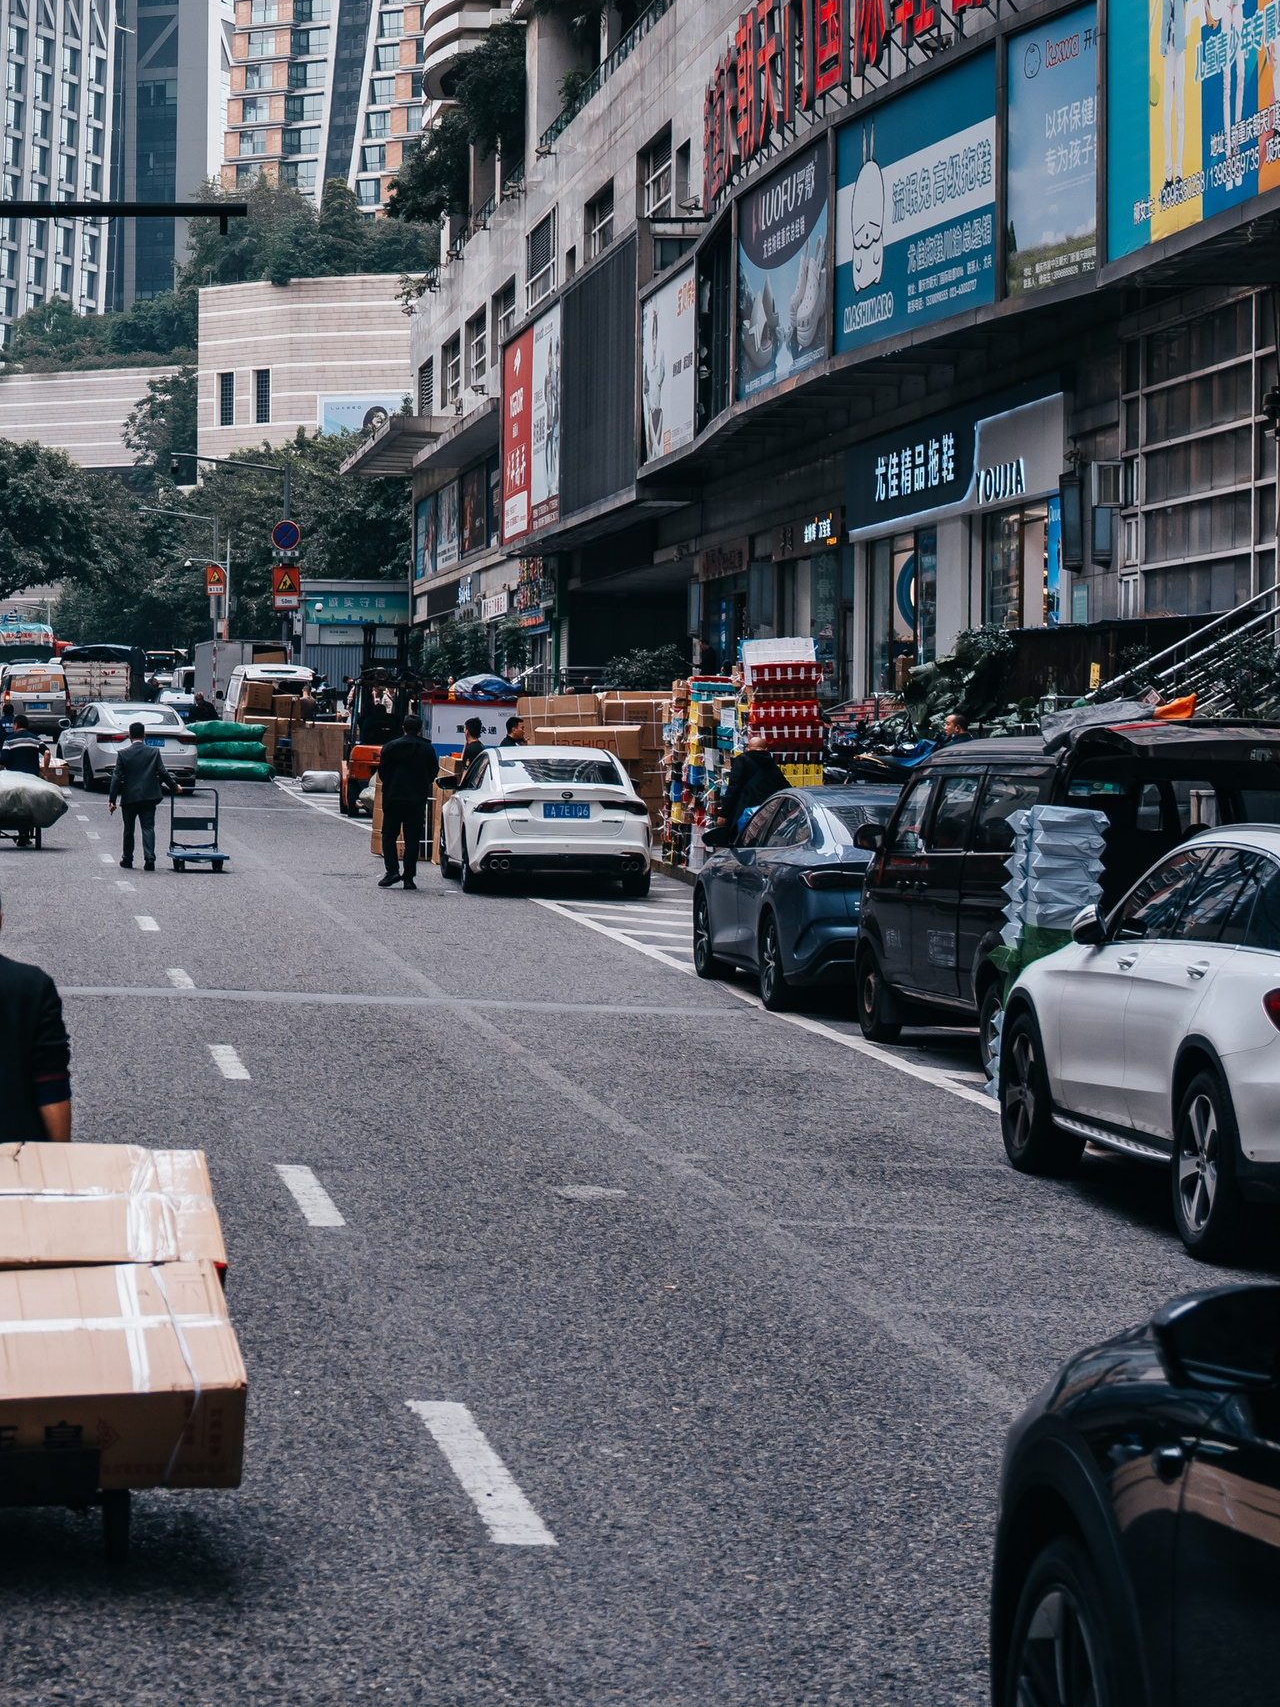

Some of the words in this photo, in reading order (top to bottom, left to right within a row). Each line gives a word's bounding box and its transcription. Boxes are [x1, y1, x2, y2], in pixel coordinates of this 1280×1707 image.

[1045, 96, 1097, 139] 以环保健
[1045, 133, 1097, 175] 专为孩子
[761, 174, 796, 231] LUOFU
[892, 139, 992, 224] 流氓兔高级拖鞋
[843, 291, 894, 334] MASHIMARO
[875, 432, 955, 502] 尤佳精品拖鞋
[975, 456, 1026, 505] YOUJIA
[280, 597, 293, 605] 50m
[456, 725, 498, 735] 重快递
